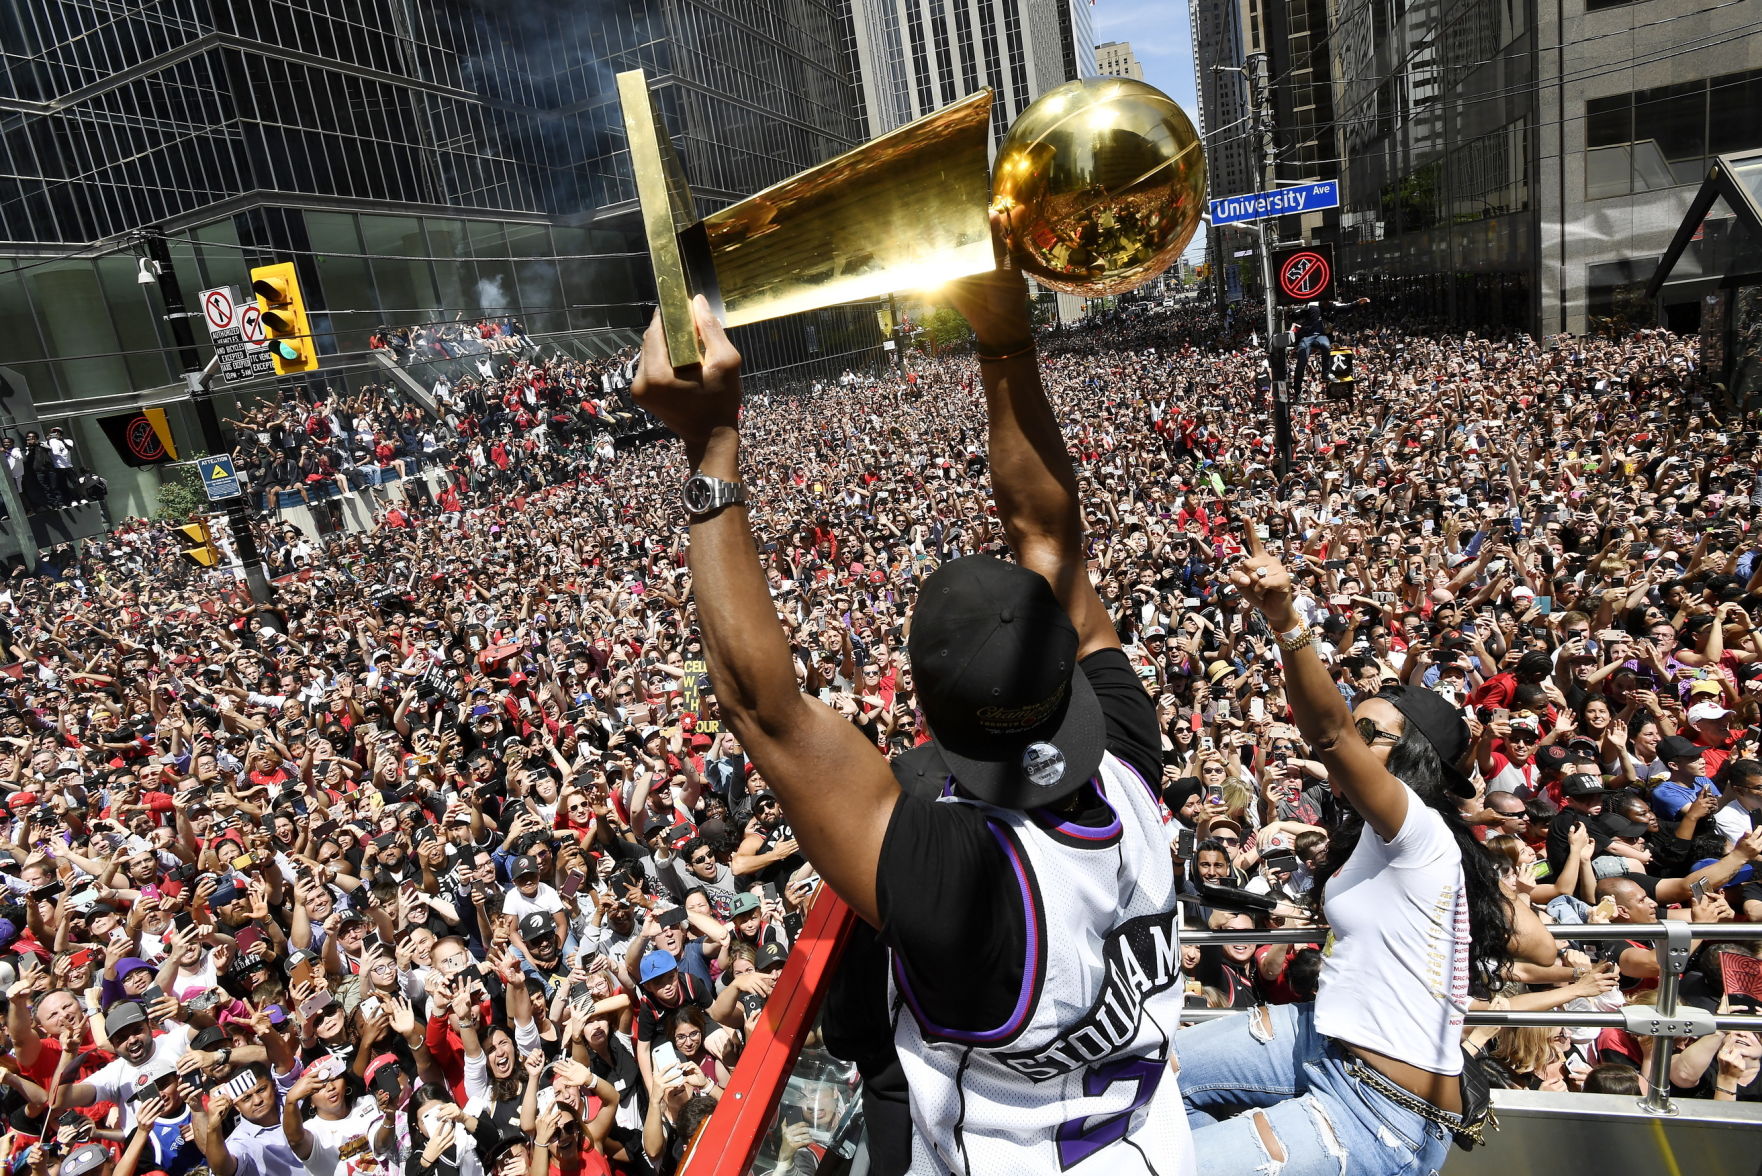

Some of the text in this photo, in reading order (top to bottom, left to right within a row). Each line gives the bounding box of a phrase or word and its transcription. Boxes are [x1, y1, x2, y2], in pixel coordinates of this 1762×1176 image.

[1216, 184, 1330, 219] University Ave
[221, 352, 244, 362] EXCEPTED
[260, 352, 272, 360] VEHIC
[202, 456, 228, 466] ATTENTION
[696, 720, 720, 733] OUR
